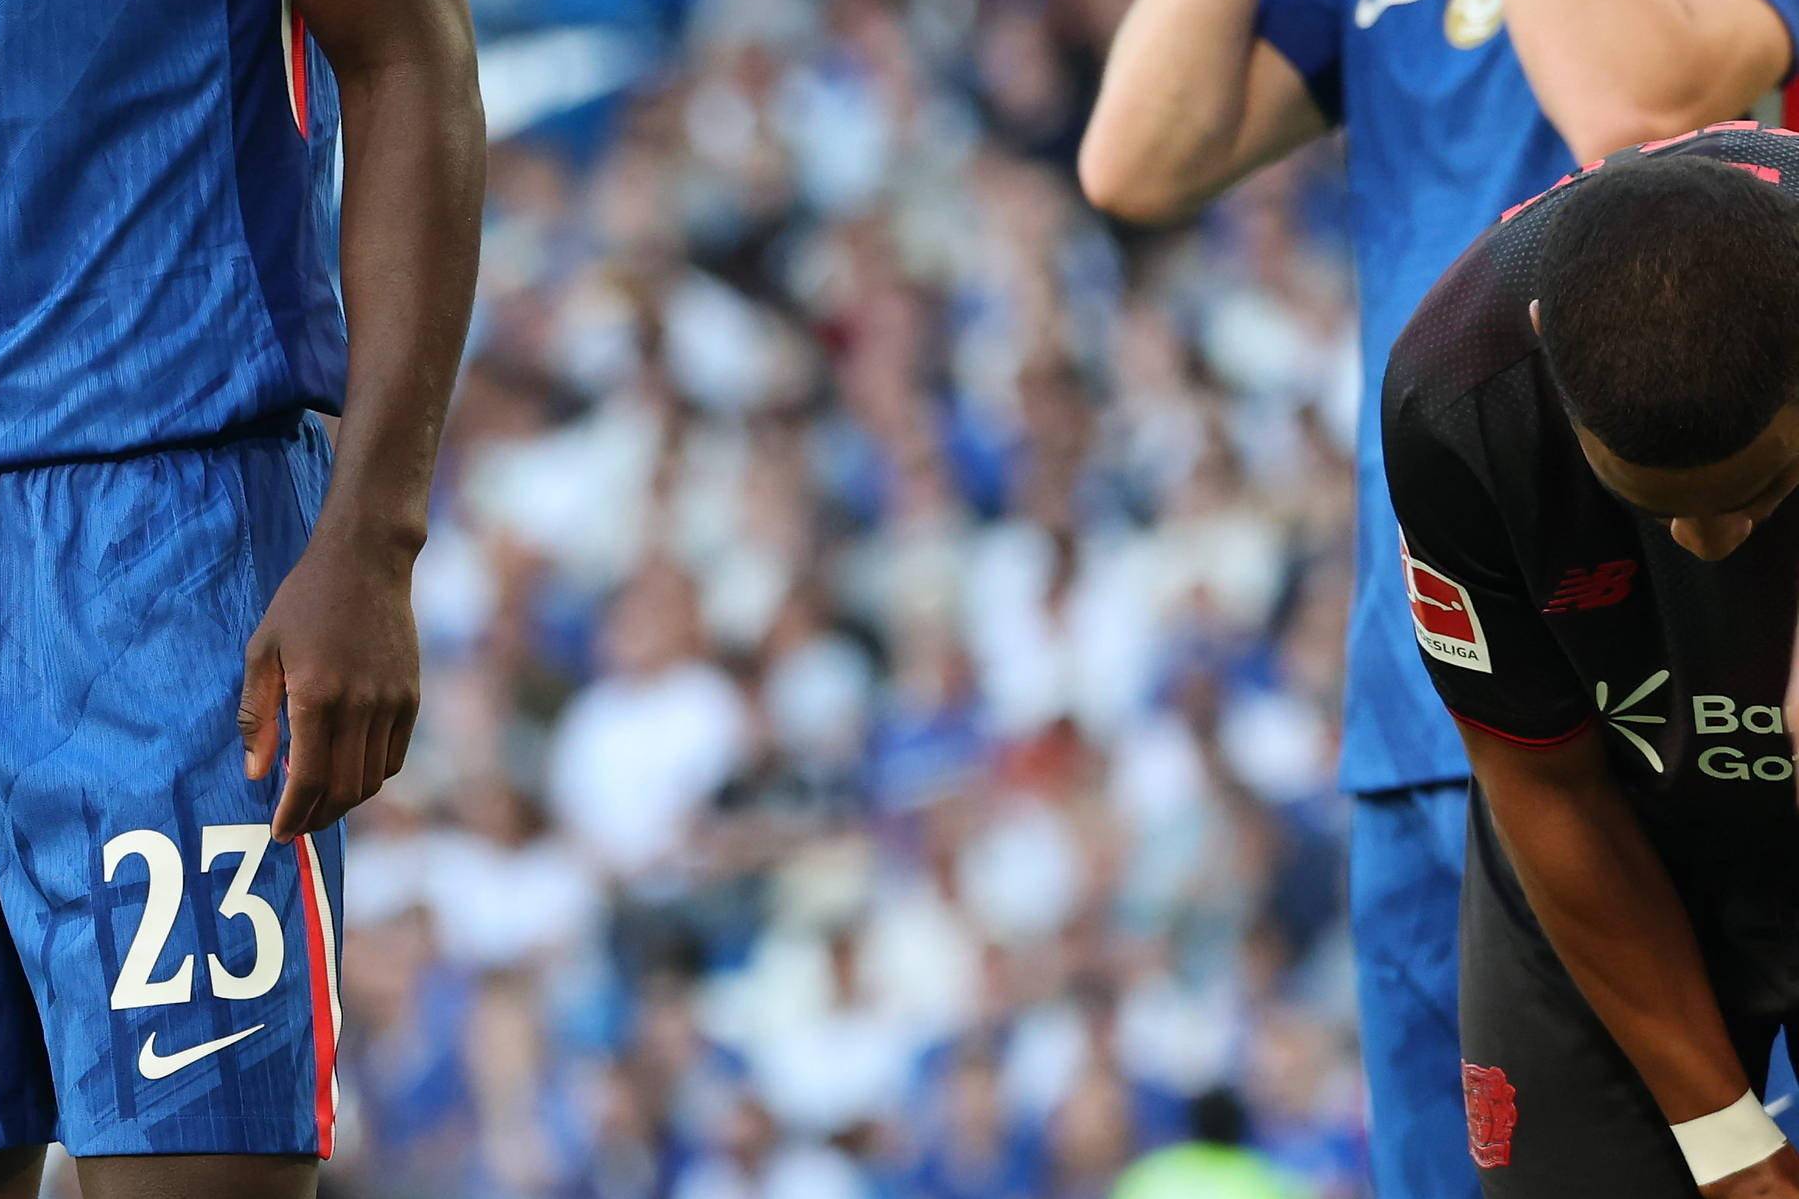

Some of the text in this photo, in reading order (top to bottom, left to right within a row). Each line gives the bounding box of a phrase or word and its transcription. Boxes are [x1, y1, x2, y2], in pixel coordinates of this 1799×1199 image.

[1692, 695, 1784, 735] Ba
[1698, 746, 1794, 781] Go
[103, 823, 285, 1010] 23
